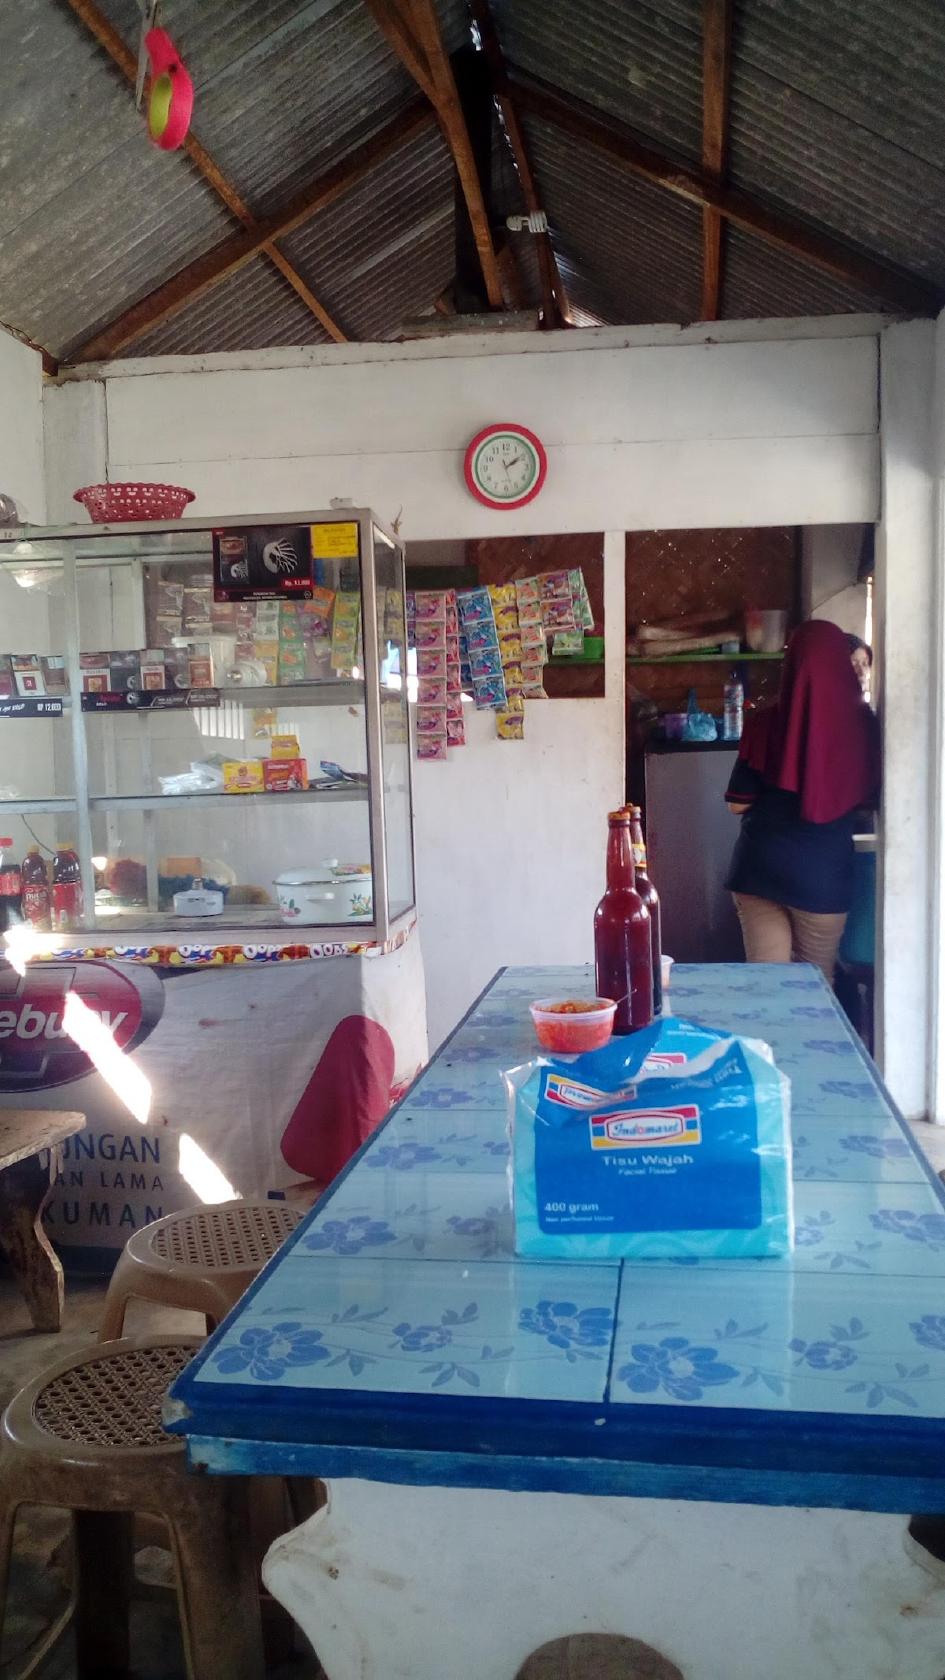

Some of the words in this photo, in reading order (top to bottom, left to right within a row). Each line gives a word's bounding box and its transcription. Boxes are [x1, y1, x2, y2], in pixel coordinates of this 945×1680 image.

[612, 1122, 680, 1137] Indomaret
[602, 1155, 638, 1167] Tisu
[641, 1153, 694, 1167] Wajah
[100, 1172, 164, 1191] LAMA
[544, 1202, 566, 1212] 400
[568, 1203, 599, 1214] gram
